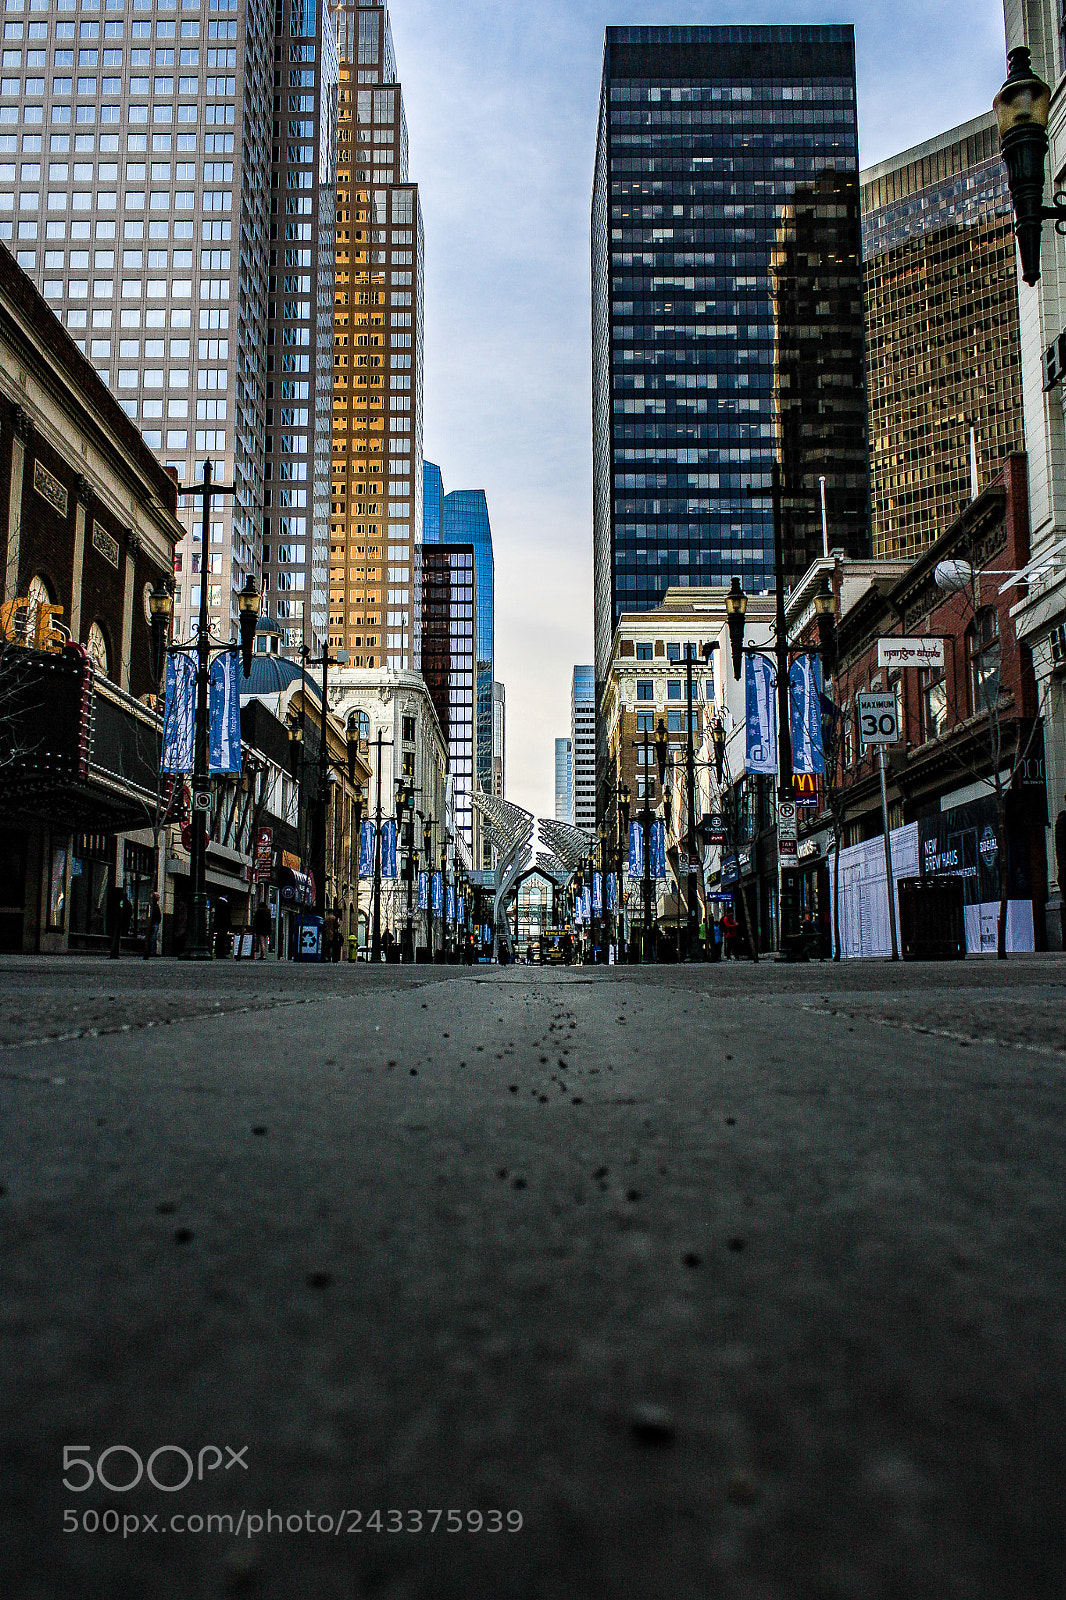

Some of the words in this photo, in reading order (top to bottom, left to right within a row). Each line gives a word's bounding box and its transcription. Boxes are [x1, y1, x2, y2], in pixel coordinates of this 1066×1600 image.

[883, 647, 915, 661] mango
[229, 681, 237, 706] Avenue
[861, 701, 894, 709] MAXIMUM
[810, 709, 819, 737] Stephen
[862, 714, 895, 735] 30
[924, 837, 938, 856] NEW
[924, 854, 941, 872] BREW
[941, 849, 958, 868] HAUS
